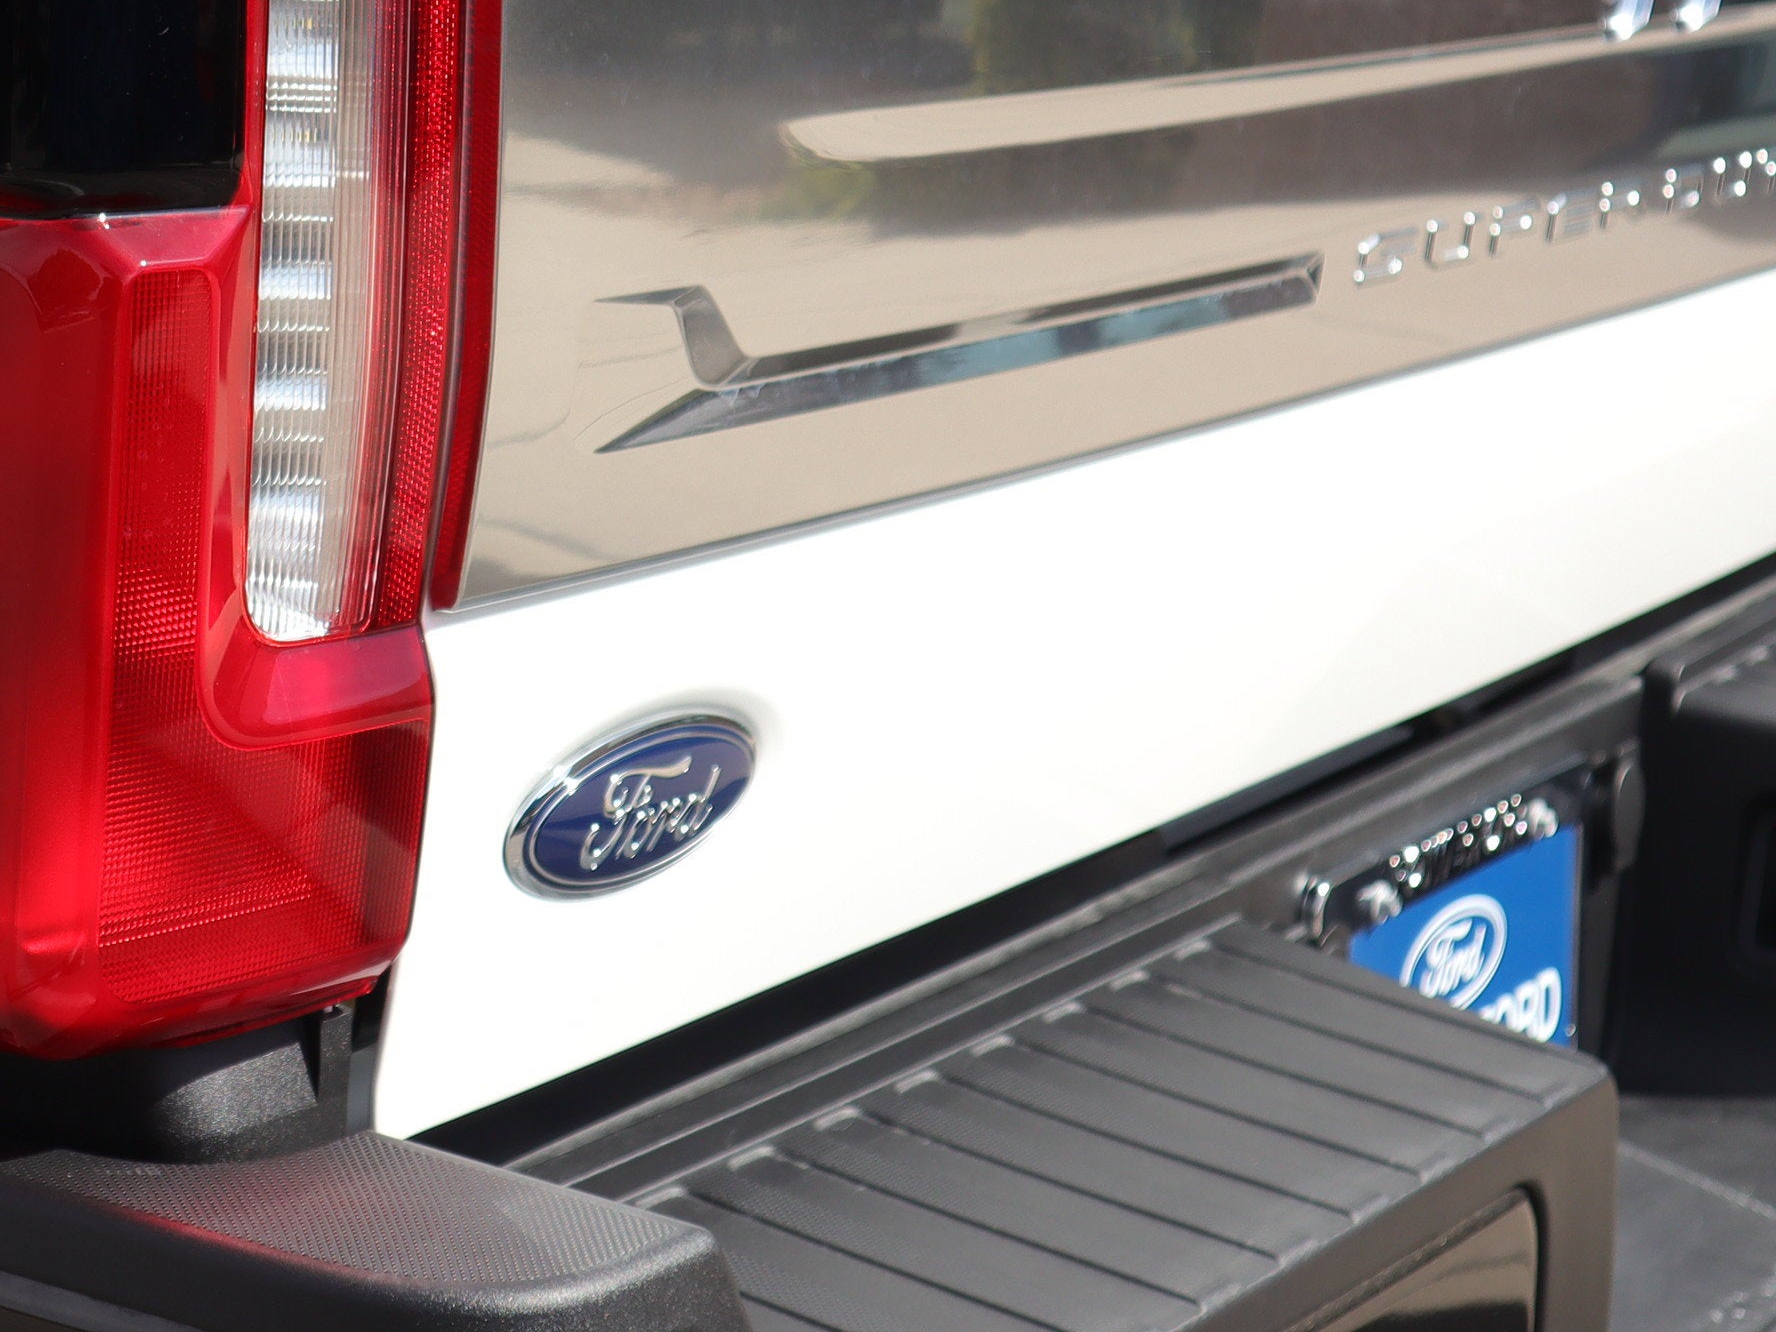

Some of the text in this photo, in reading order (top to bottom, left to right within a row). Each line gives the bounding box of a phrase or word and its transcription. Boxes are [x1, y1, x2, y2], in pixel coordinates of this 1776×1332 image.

[580, 755, 722, 872] Ford
[1420, 919, 1486, 999] Ford
[1479, 967, 1562, 1044] ORD
